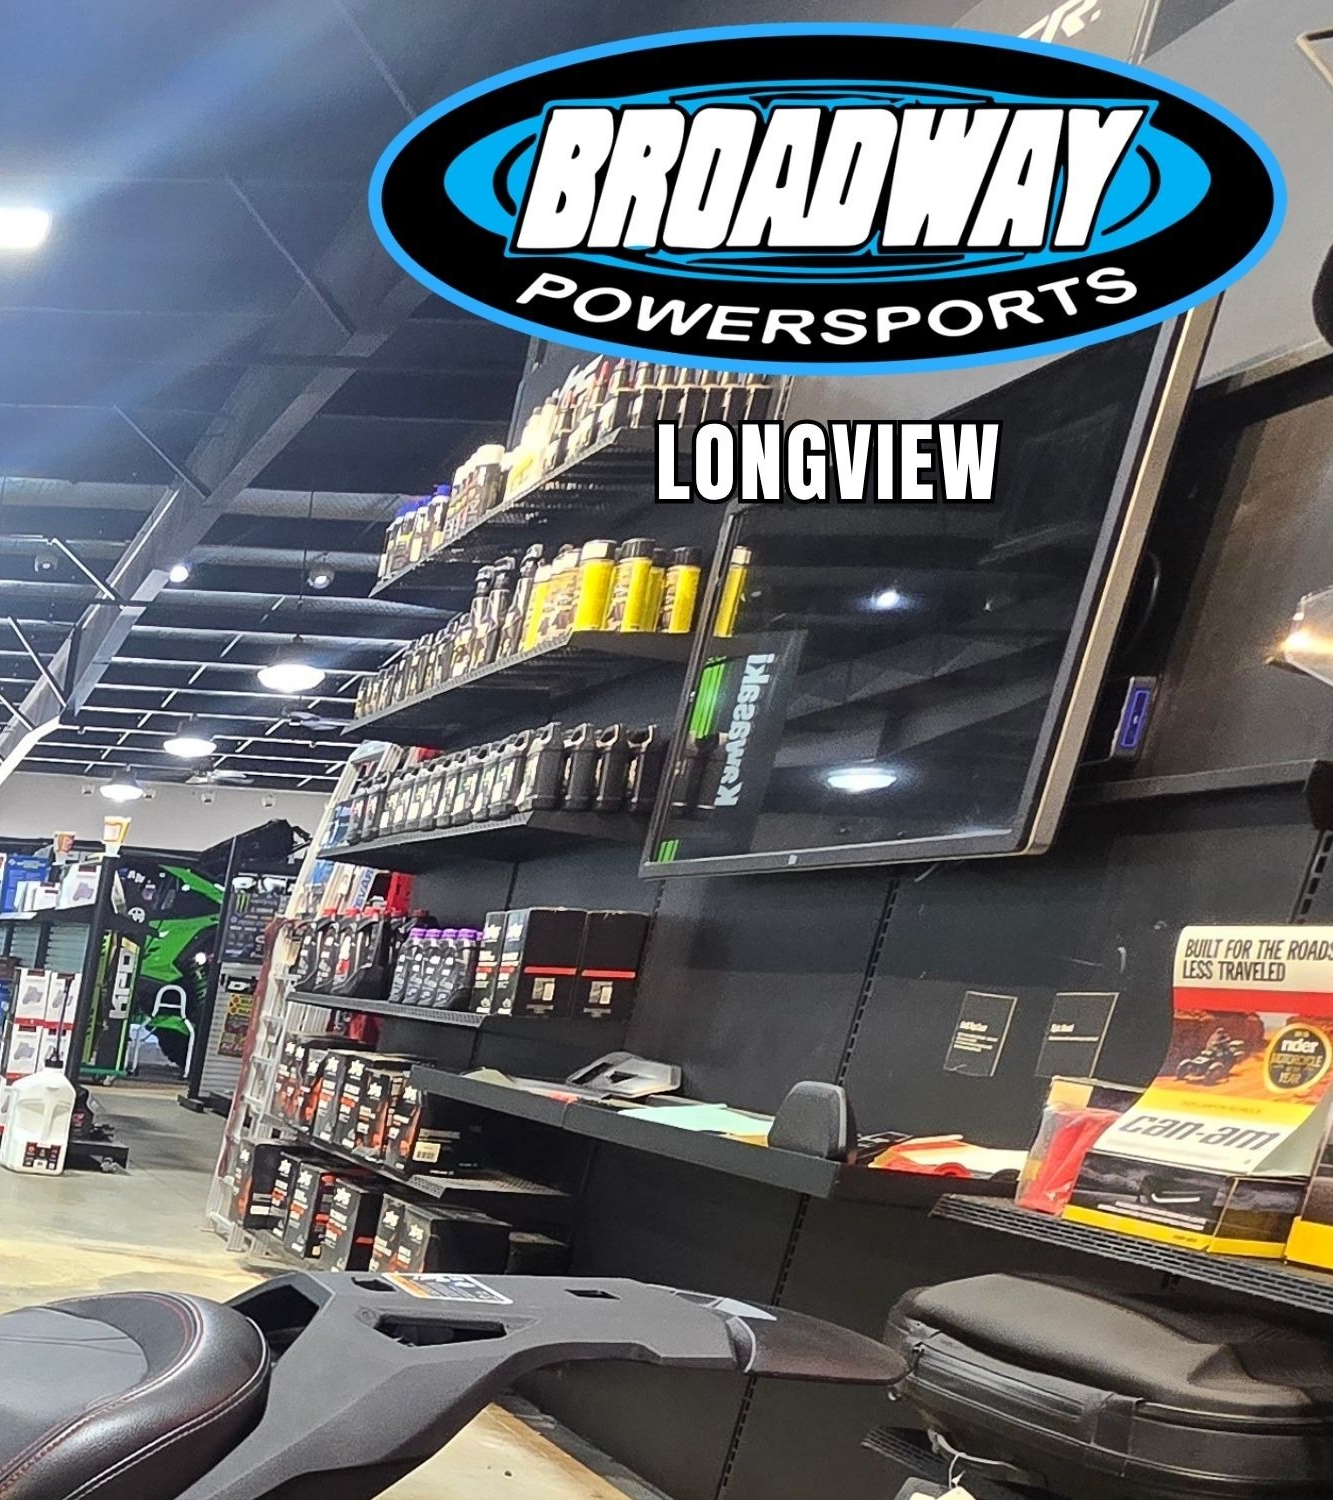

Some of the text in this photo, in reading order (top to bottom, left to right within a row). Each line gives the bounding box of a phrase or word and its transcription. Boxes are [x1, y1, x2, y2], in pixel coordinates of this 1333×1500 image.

[1185, 938, 1333, 961] BUILT FOR THE ROADS
[1183, 959, 1286, 982] LESS TRAVELED
[1118, 1115, 1280, 1151] can-am
